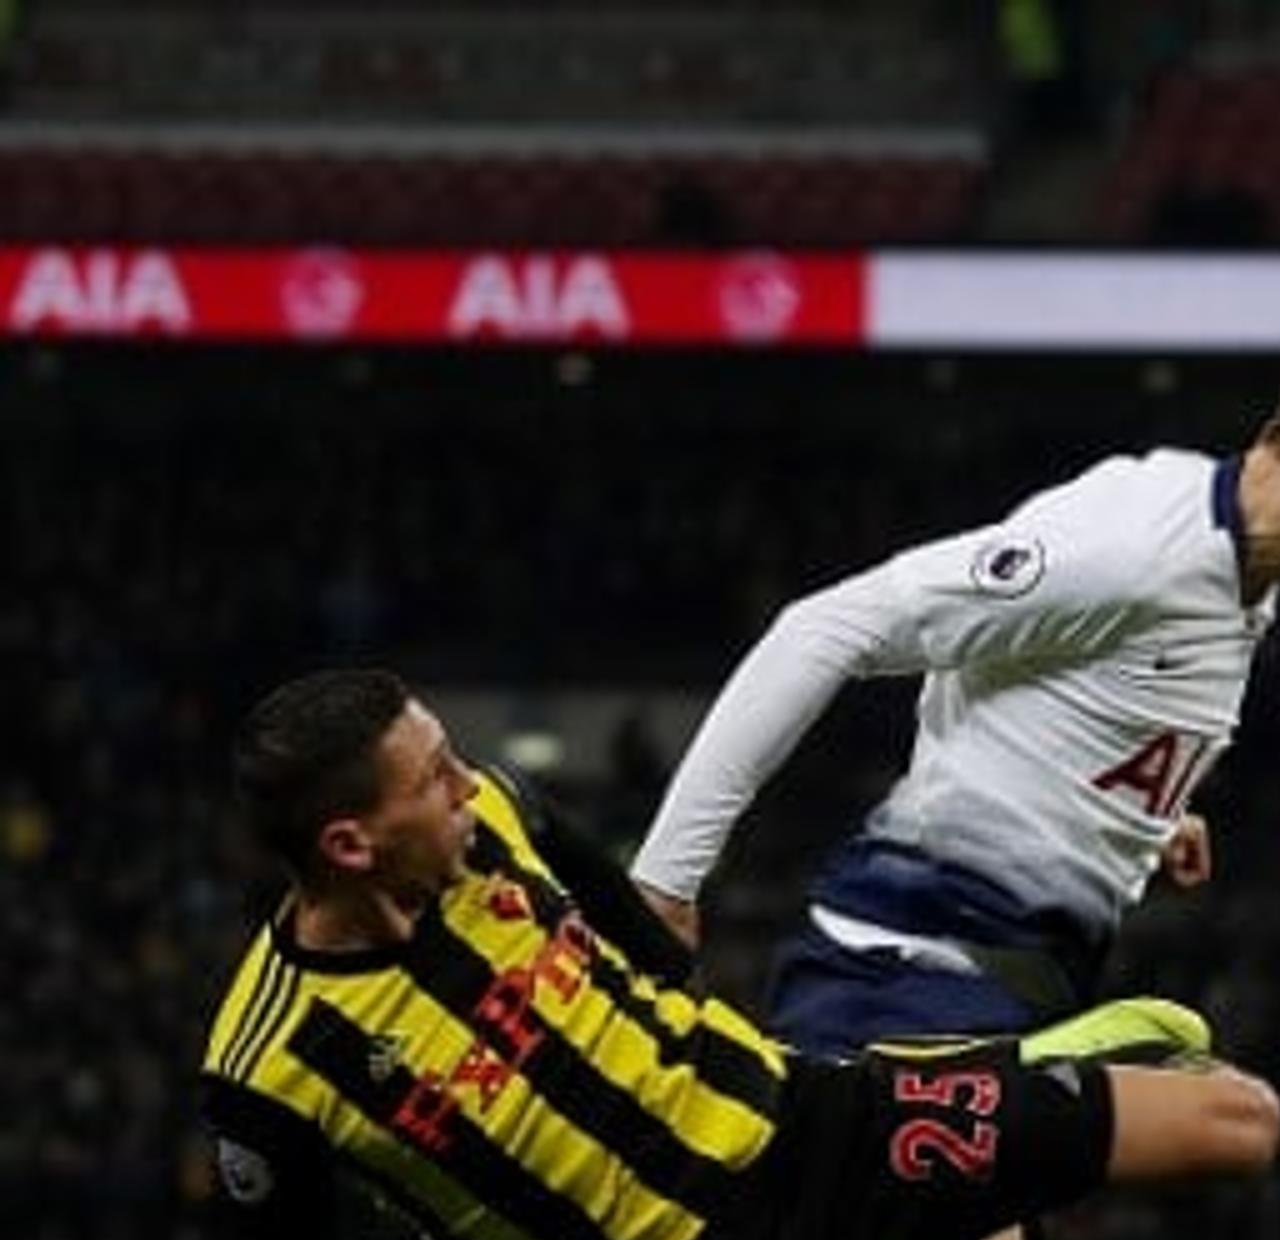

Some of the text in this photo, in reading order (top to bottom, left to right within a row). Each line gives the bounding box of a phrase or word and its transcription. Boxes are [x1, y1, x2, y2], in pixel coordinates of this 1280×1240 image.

[10, 249, 192, 335] AIA
[449, 253, 629, 335] AIA
[891, 1070, 1001, 1180] 25
